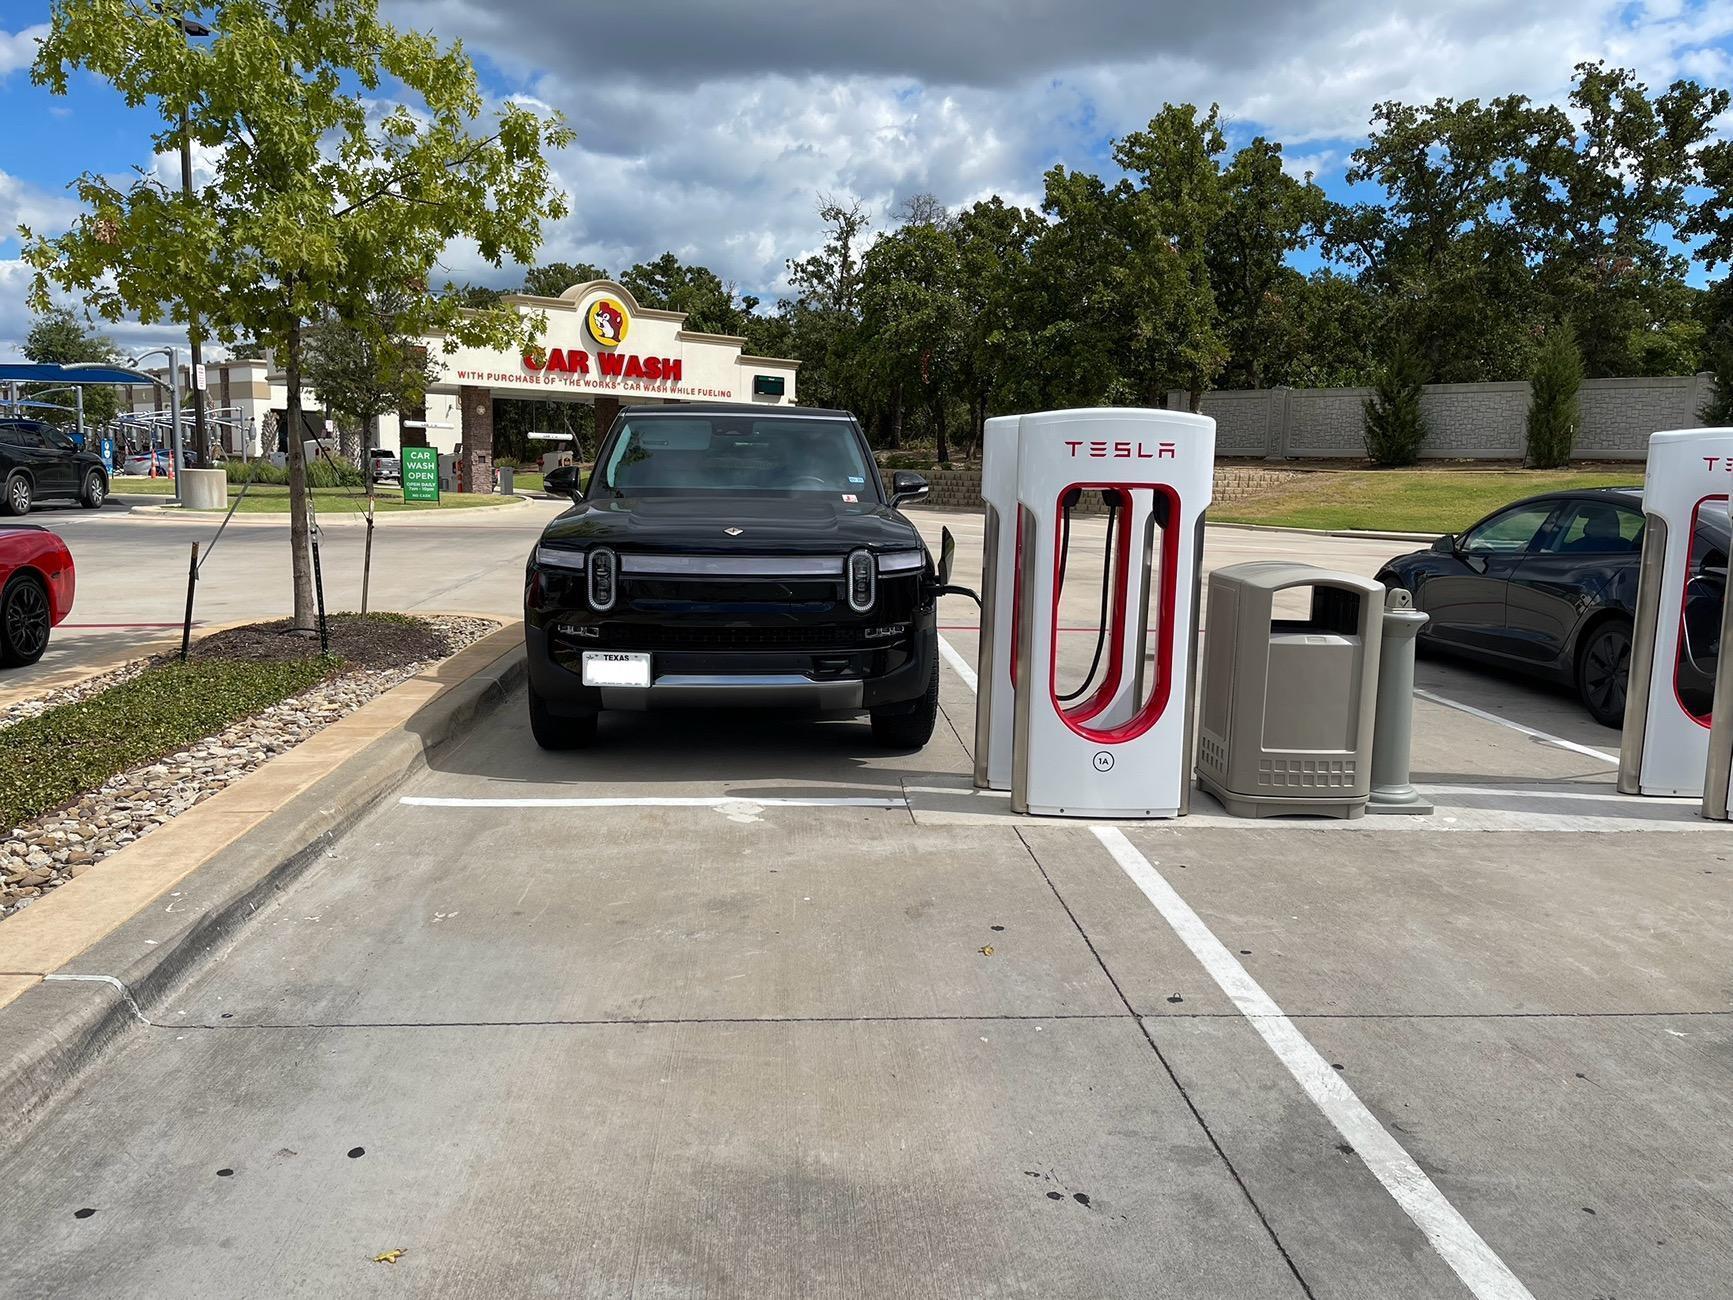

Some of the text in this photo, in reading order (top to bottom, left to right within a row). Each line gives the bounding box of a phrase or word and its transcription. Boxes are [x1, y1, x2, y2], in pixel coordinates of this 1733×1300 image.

[523, 348, 682, 381] CAR WASH
[457, 370, 484, 380] WITH
[487, 373, 541, 384] PURCHASE
[544, 377, 556, 385] OF
[623, 382, 641, 391] CAR
[643, 384, 668, 394] WASH
[670, 386, 696, 396] WHILE
[697, 388, 732, 398] FUELING
[1064, 441, 1175, 458] TESLA
[410, 451, 430, 460] CAR
[406, 462, 435, 470] WASH
[408, 472, 434, 480] OPEN
[1098, 757, 1109, 765] 1A
